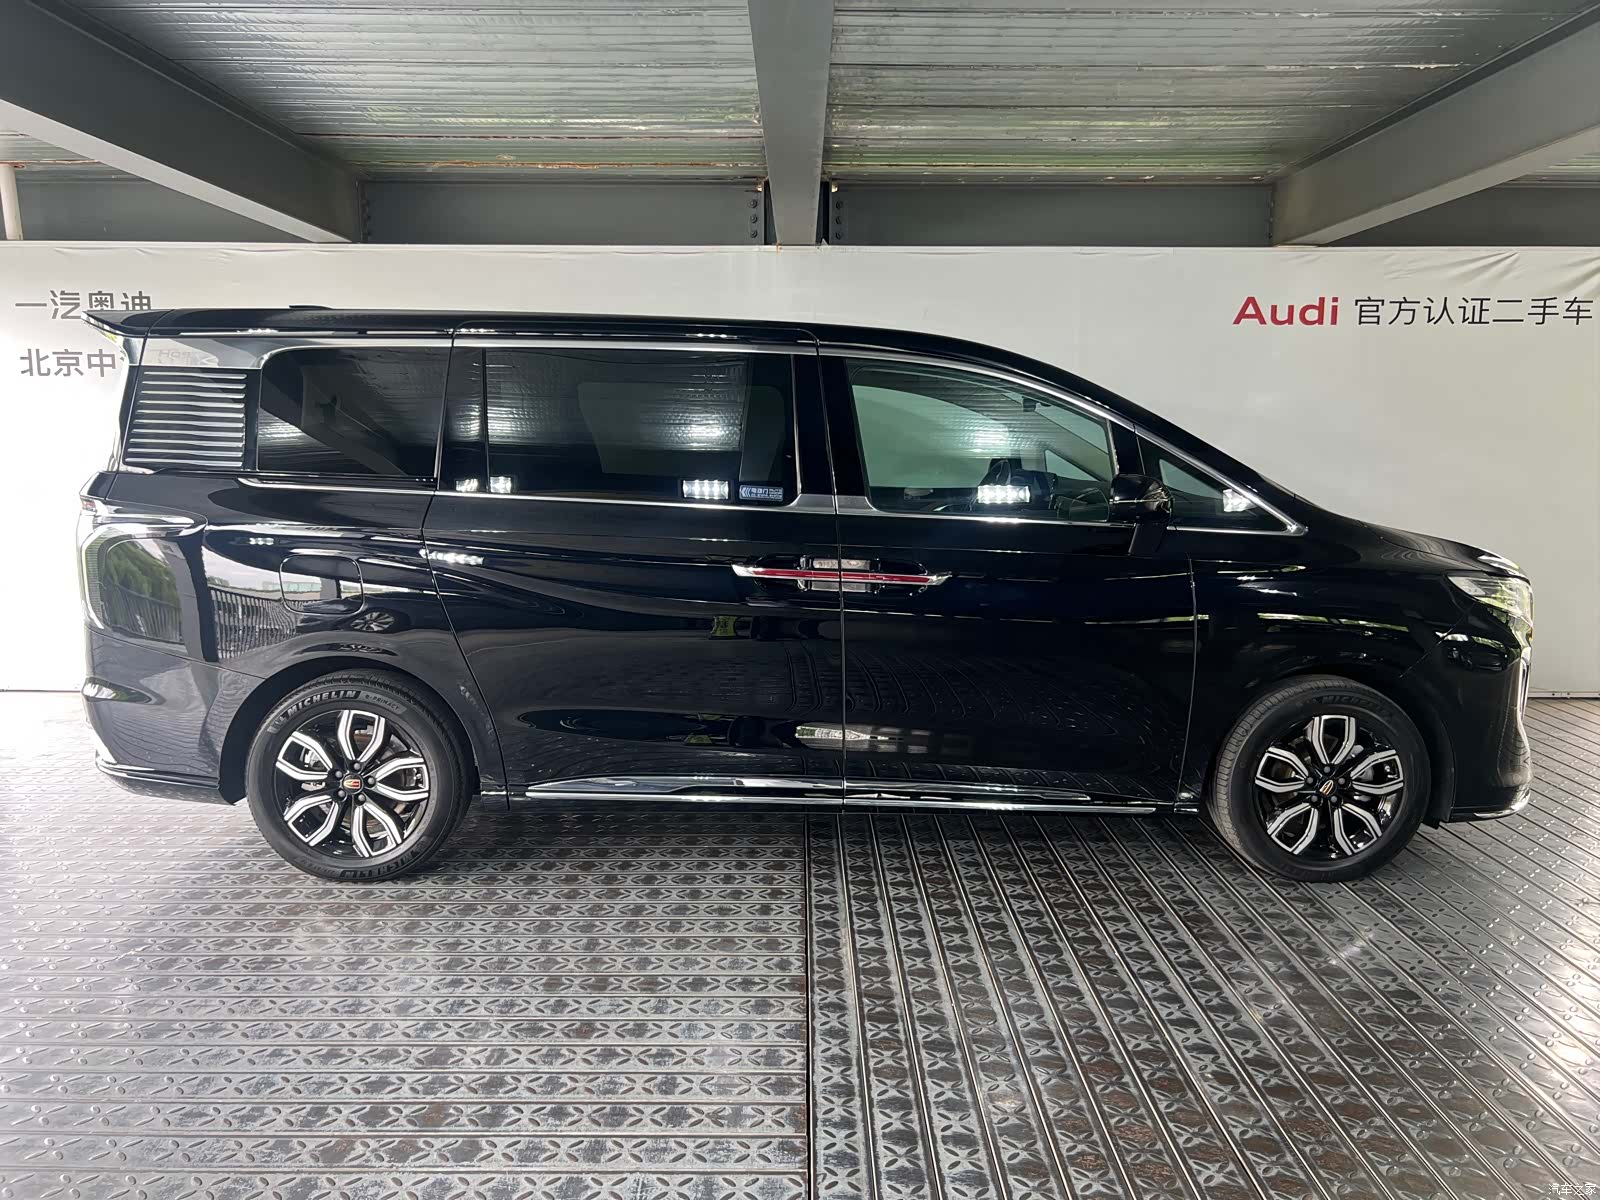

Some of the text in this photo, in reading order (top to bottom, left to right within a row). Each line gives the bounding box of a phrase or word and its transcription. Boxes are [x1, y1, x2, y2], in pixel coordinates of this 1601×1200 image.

[1232, 296, 1594, 326] Audi 官方认证二手车
[20, 348, 126, 377] 北京中
[287, 690, 356, 717] MICHELIN
